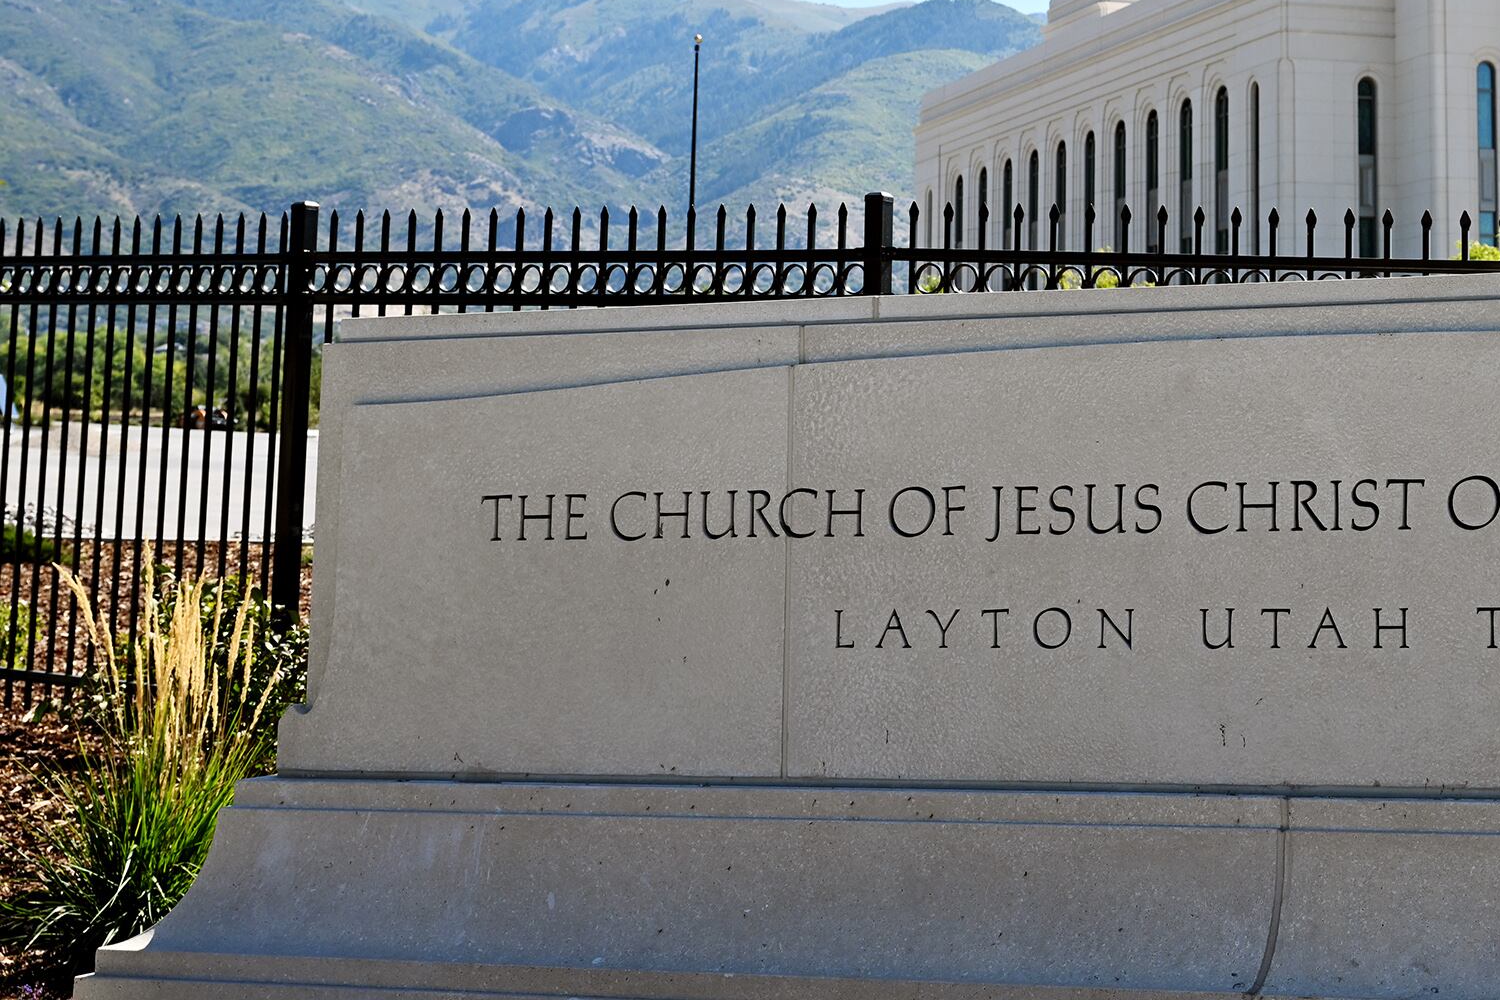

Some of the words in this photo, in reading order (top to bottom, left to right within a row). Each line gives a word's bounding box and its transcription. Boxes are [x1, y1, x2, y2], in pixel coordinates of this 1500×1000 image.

[480, 493, 588, 542] THE
[610, 487, 866, 542] CHURCH
[888, 485, 966, 538] OF
[985, 483, 1162, 542] JESUS
[1186, 478, 1426, 535] CHRIST
[834, 607, 1135, 651] LAYTON
[1199, 606, 1410, 650] UTAH
